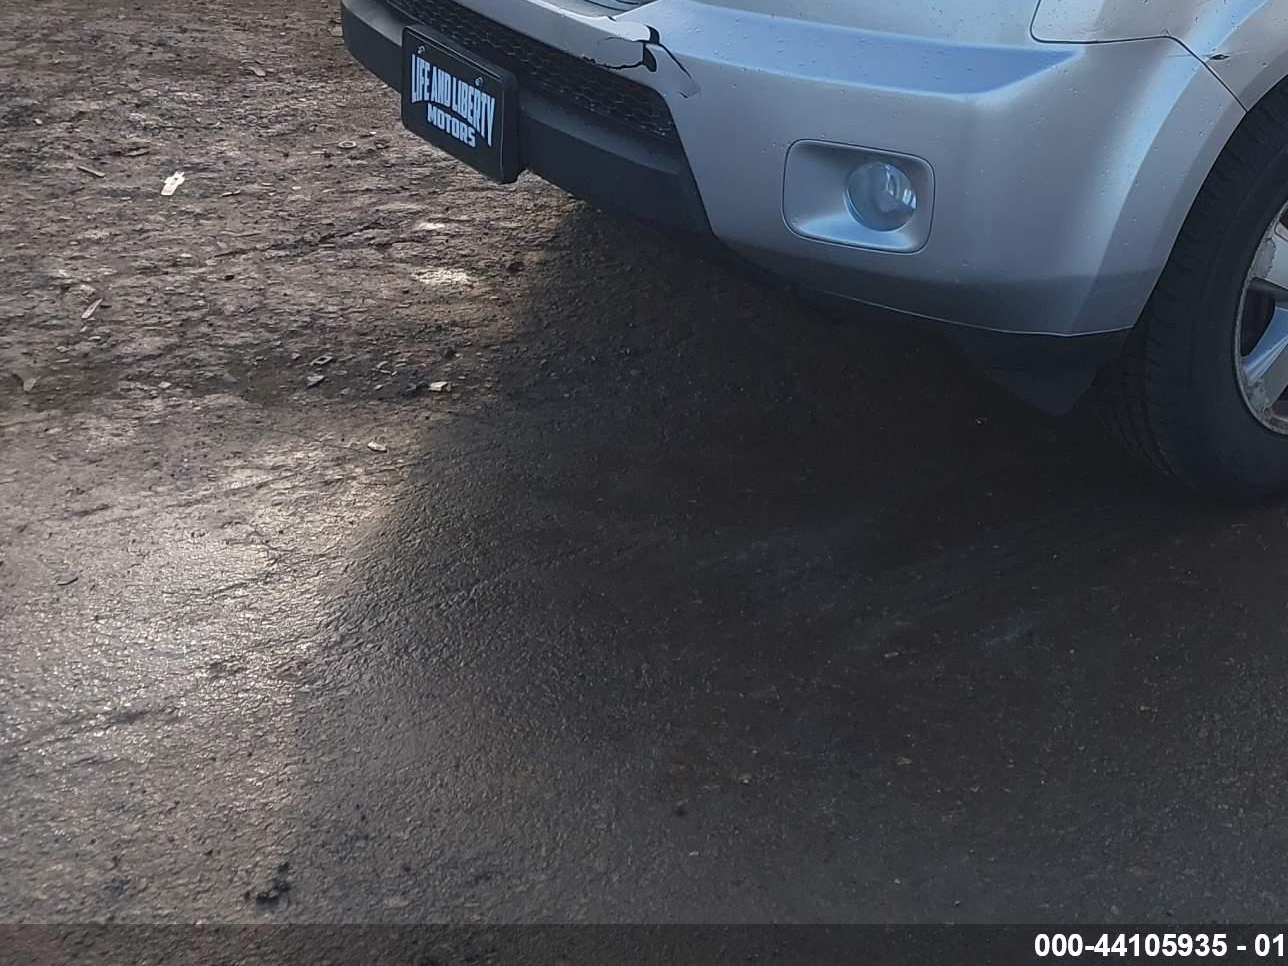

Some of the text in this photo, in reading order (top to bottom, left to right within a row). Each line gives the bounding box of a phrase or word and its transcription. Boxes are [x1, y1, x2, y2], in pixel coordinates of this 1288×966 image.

[411, 53, 496, 147] LIFE AND LIBERTY
[427, 102, 476, 148] MOTORS
